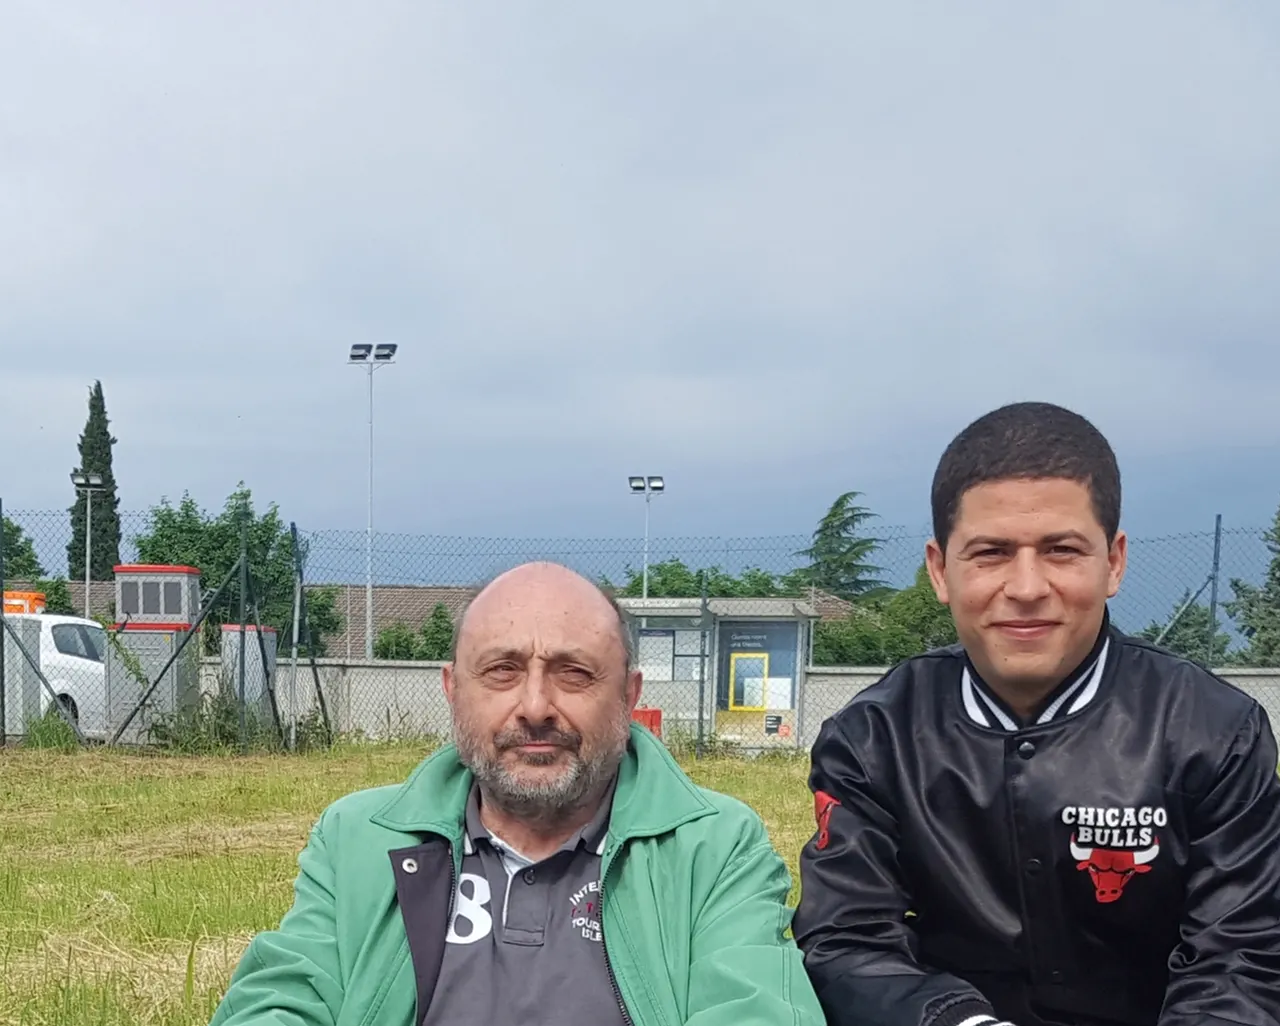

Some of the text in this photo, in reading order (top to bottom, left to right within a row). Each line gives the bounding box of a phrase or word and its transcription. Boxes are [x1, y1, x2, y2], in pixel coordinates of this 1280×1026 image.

[1061, 806, 1167, 828] CHICAGO
[1077, 826, 1152, 847] BULLS
[445, 873, 493, 945] 8
[582, 927, 602, 942] ISLE
